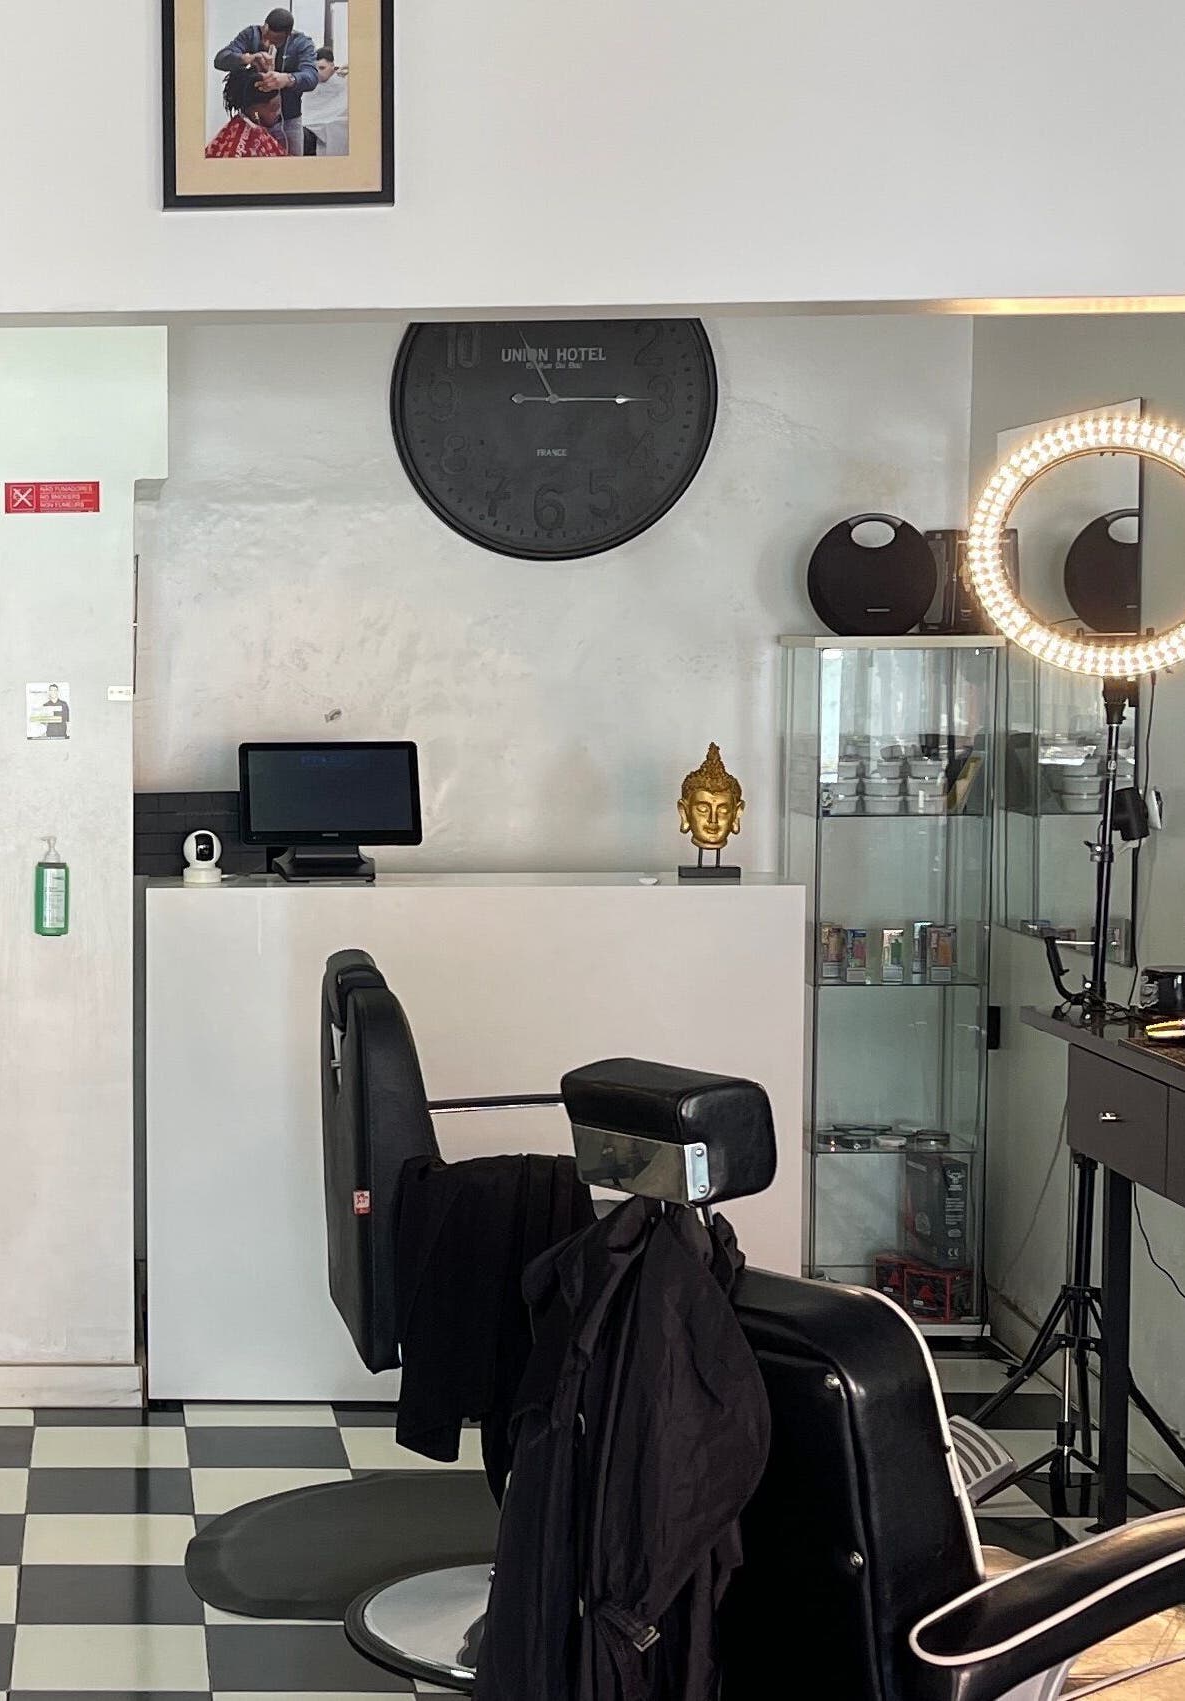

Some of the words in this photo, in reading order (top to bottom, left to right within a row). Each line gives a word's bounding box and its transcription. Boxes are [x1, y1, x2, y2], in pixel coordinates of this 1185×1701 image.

[501, 347, 548, 362] UNION
[556, 347, 606, 361] HOTEL
[536, 448, 568, 458] FRANCE
